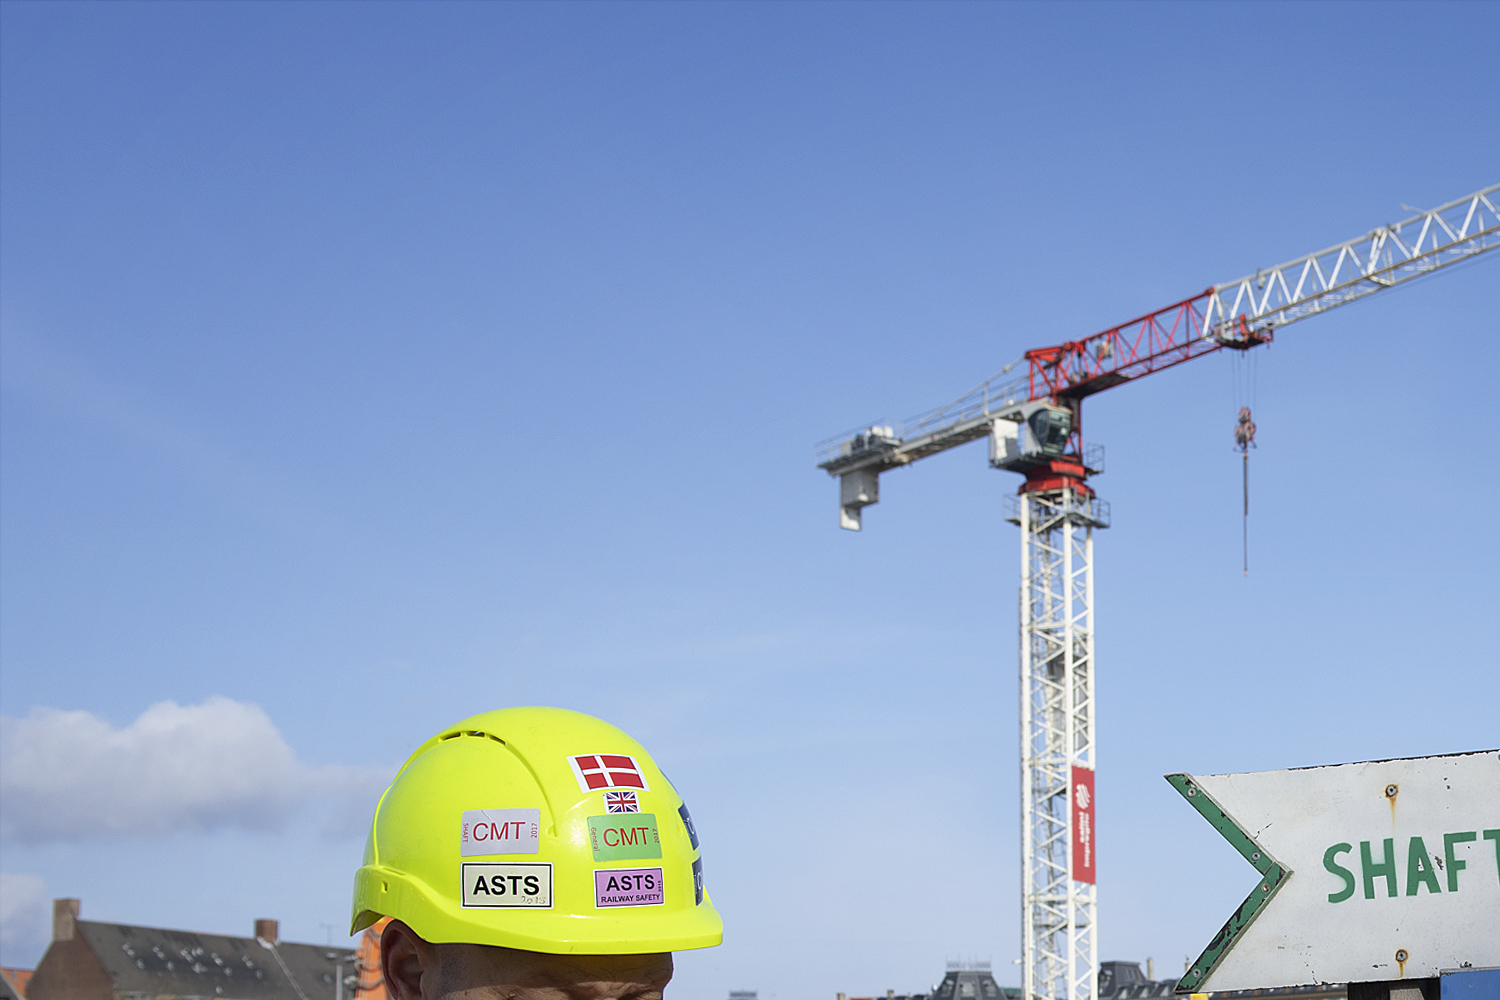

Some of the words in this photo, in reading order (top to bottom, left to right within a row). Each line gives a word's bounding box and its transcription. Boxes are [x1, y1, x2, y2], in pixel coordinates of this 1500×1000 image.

[472, 822, 526, 842] CMT
[530, 822, 538, 838] 2017
[590, 826, 600, 852] General
[603, 827, 649, 847] CMT
[472, 875, 540, 896] ASTS
[606, 874, 655, 892] ASTS
[600, 895, 634, 903] RAILWAY
[635, 894, 661, 902] SAFETY
